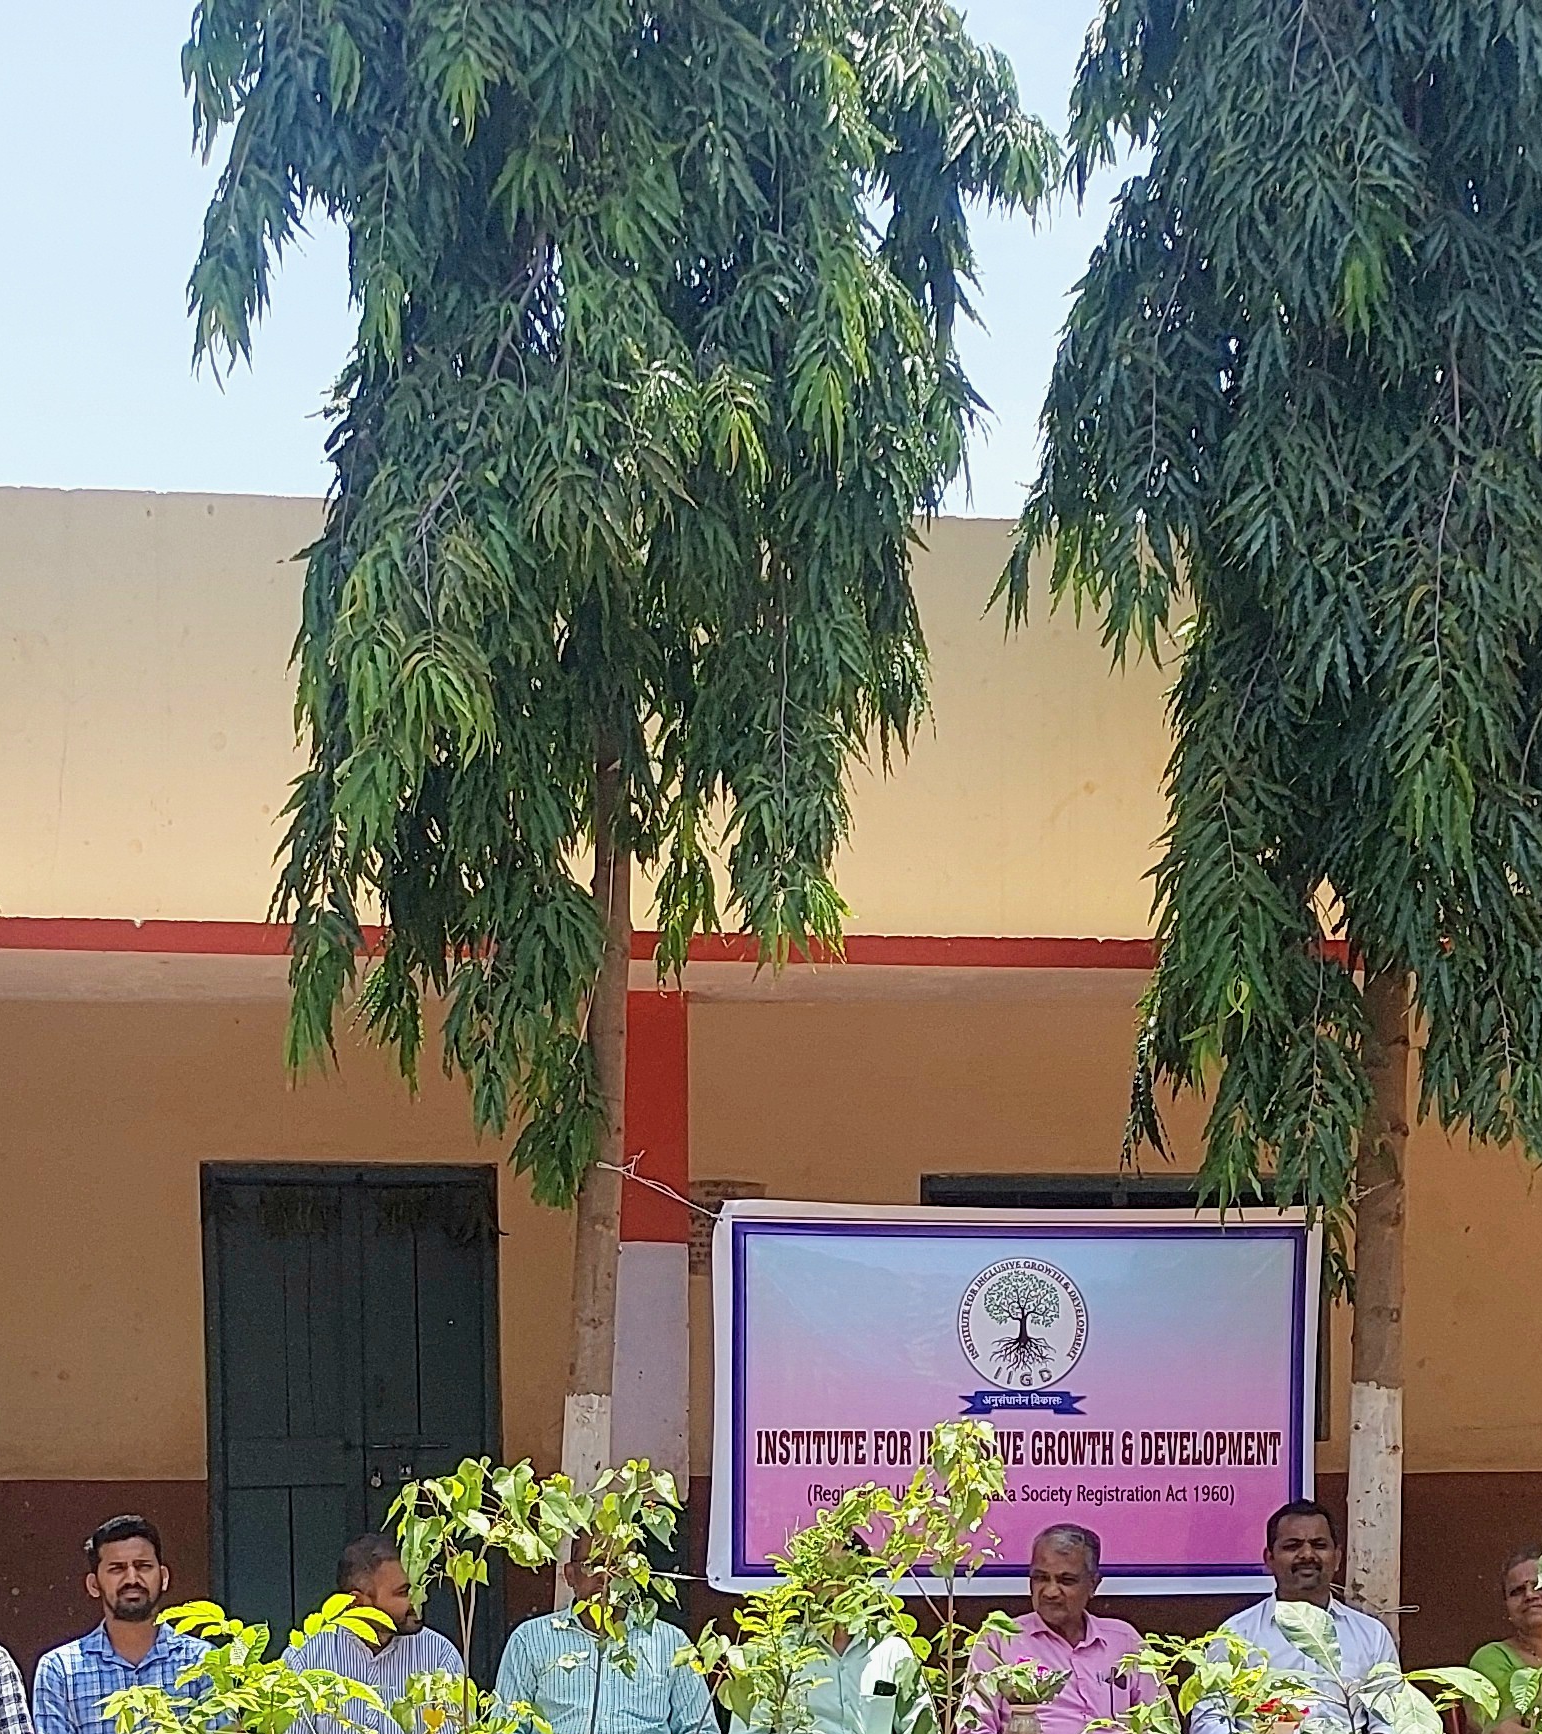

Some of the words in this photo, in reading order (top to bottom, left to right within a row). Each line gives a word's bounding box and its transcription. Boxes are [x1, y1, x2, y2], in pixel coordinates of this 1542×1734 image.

[756, 1430, 867, 1465] INSTITUTE
[873, 1430, 912, 1465] FOR
[919, 1430, 1025, 1465] ISIVE
[1031, 1430, 1114, 1466] GROWTH
[1121, 1430, 1134, 1466] &
[1140, 1431, 1282, 1466] DEVELOPMENT
[1021, 1484, 1071, 1506] Society
[1077, 1484, 1160, 1506] Registration
[1165, 1485, 1188, 1502] Act
[1194, 1484, 1235, 1506] 1960)
